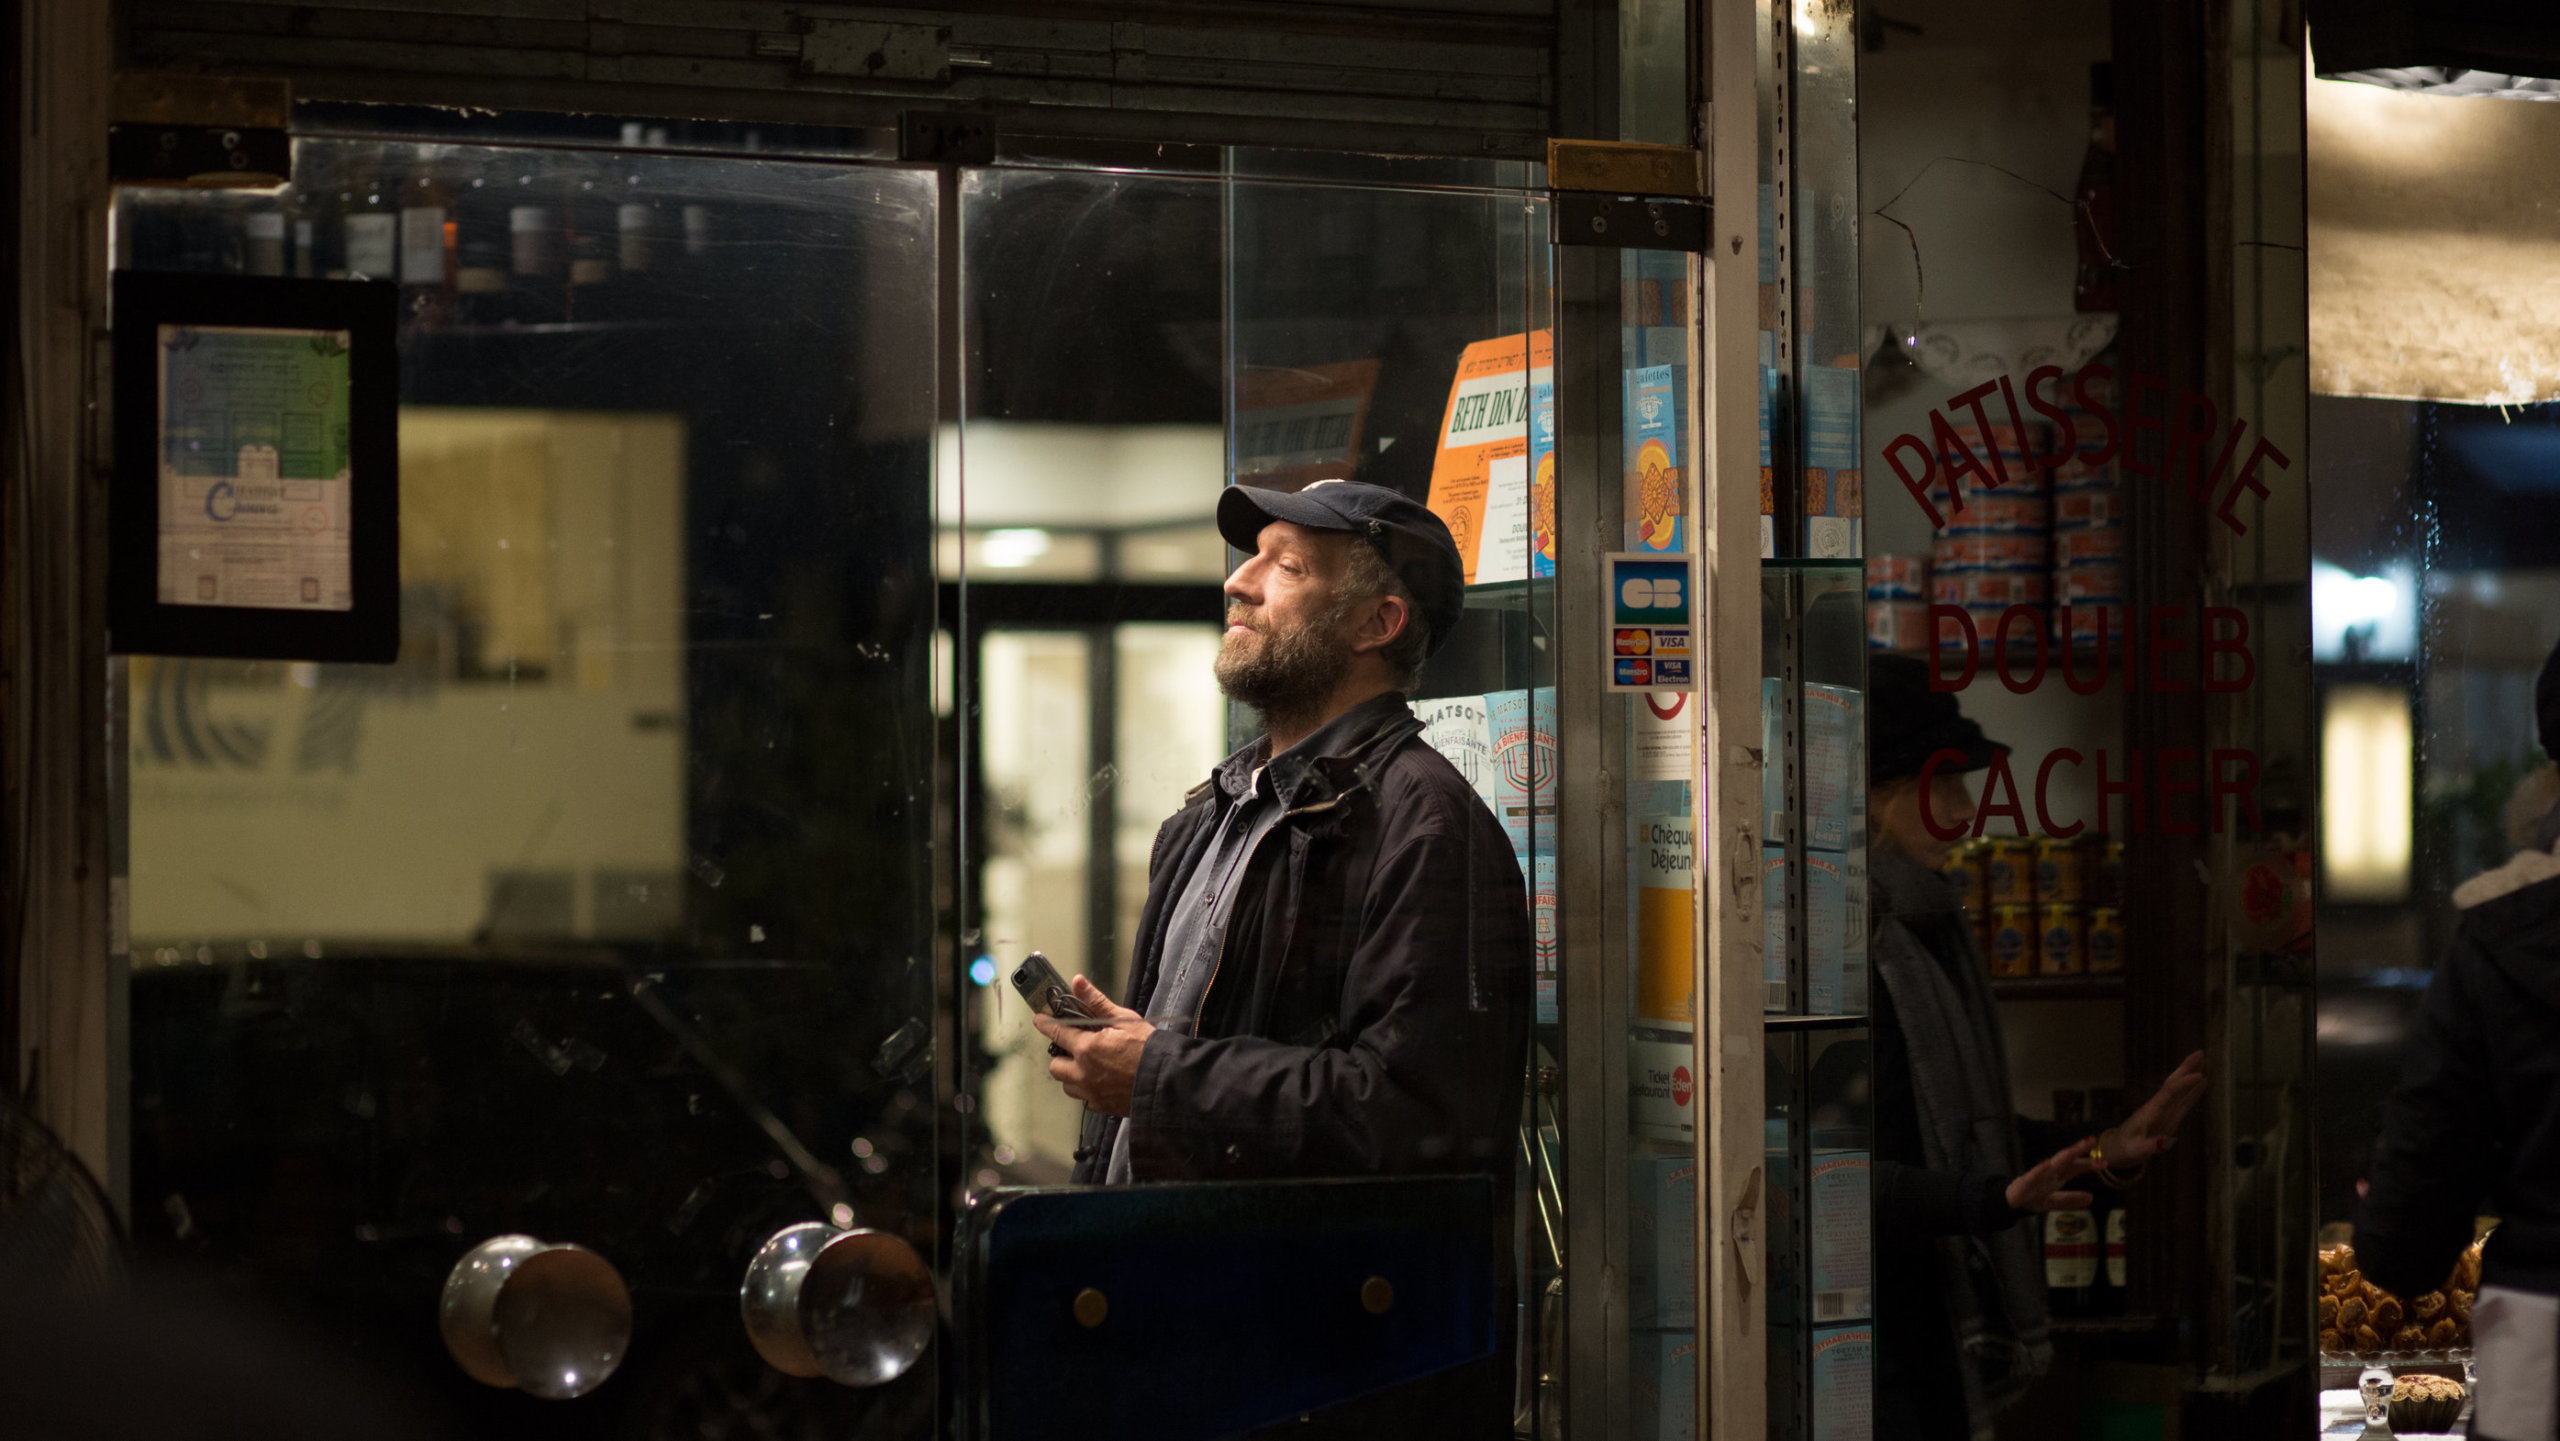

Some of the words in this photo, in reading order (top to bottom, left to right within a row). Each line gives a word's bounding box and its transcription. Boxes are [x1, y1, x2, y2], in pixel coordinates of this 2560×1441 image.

[1451, 393, 1490, 433] BETH
[1487, 388, 1518, 427] DIN
[1881, 363, 2291, 537] PATISSERIE
[1622, 578, 1682, 609] CB
[1660, 637, 1685, 647] VISA
[1928, 604, 2255, 696] DOUIEB
[1618, 668, 1648, 677] Maestro
[1657, 674, 1689, 683] Electron
[1664, 662, 1682, 670] VISA
[1425, 705, 1485, 731] MATSOT
[1918, 747, 2262, 841] CACHER
[1651, 848, 1691, 874] Déjeun
[1648, 1070, 1670, 1085] Ticket
